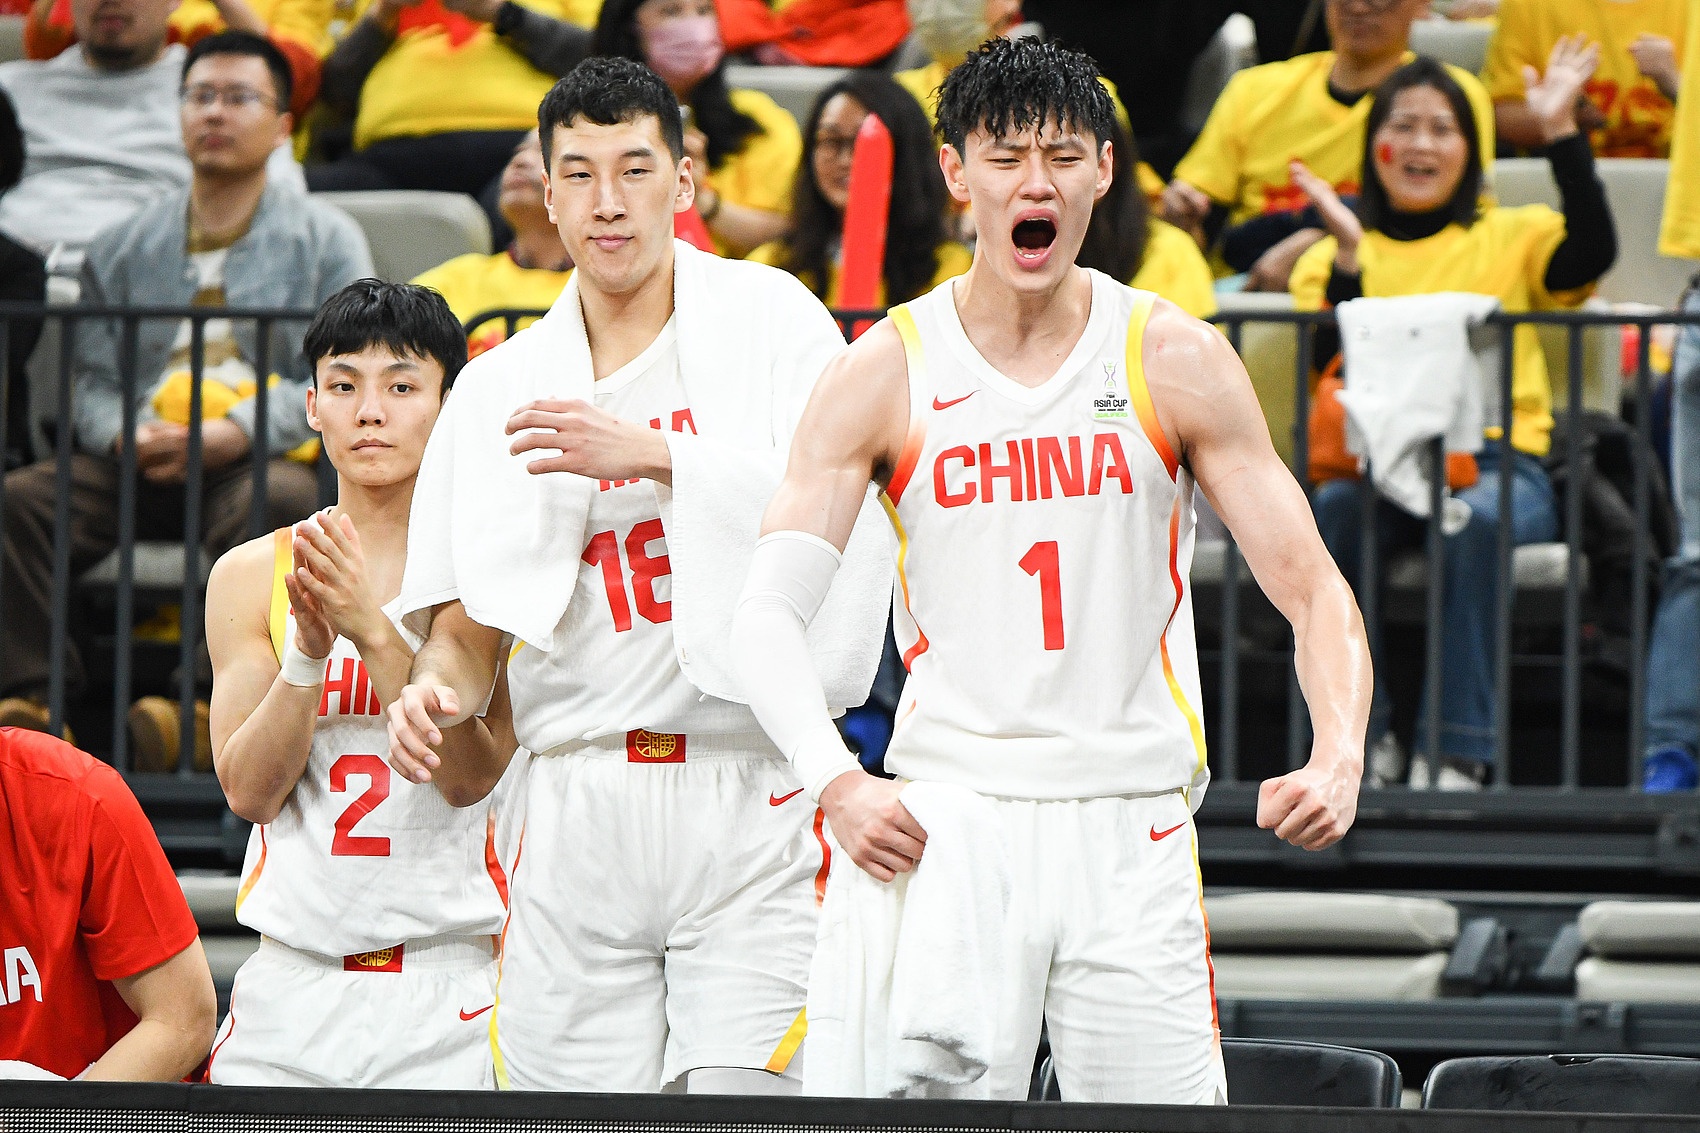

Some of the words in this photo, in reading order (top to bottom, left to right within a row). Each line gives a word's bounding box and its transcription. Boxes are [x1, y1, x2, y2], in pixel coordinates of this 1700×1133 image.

[1094, 400, 1111, 408] ASIA
[1112, 399, 1128, 408] CUP
[933, 433, 1134, 509] CHINA
[1018, 540, 1065, 650] 1
[329, 754, 391, 857] 2
